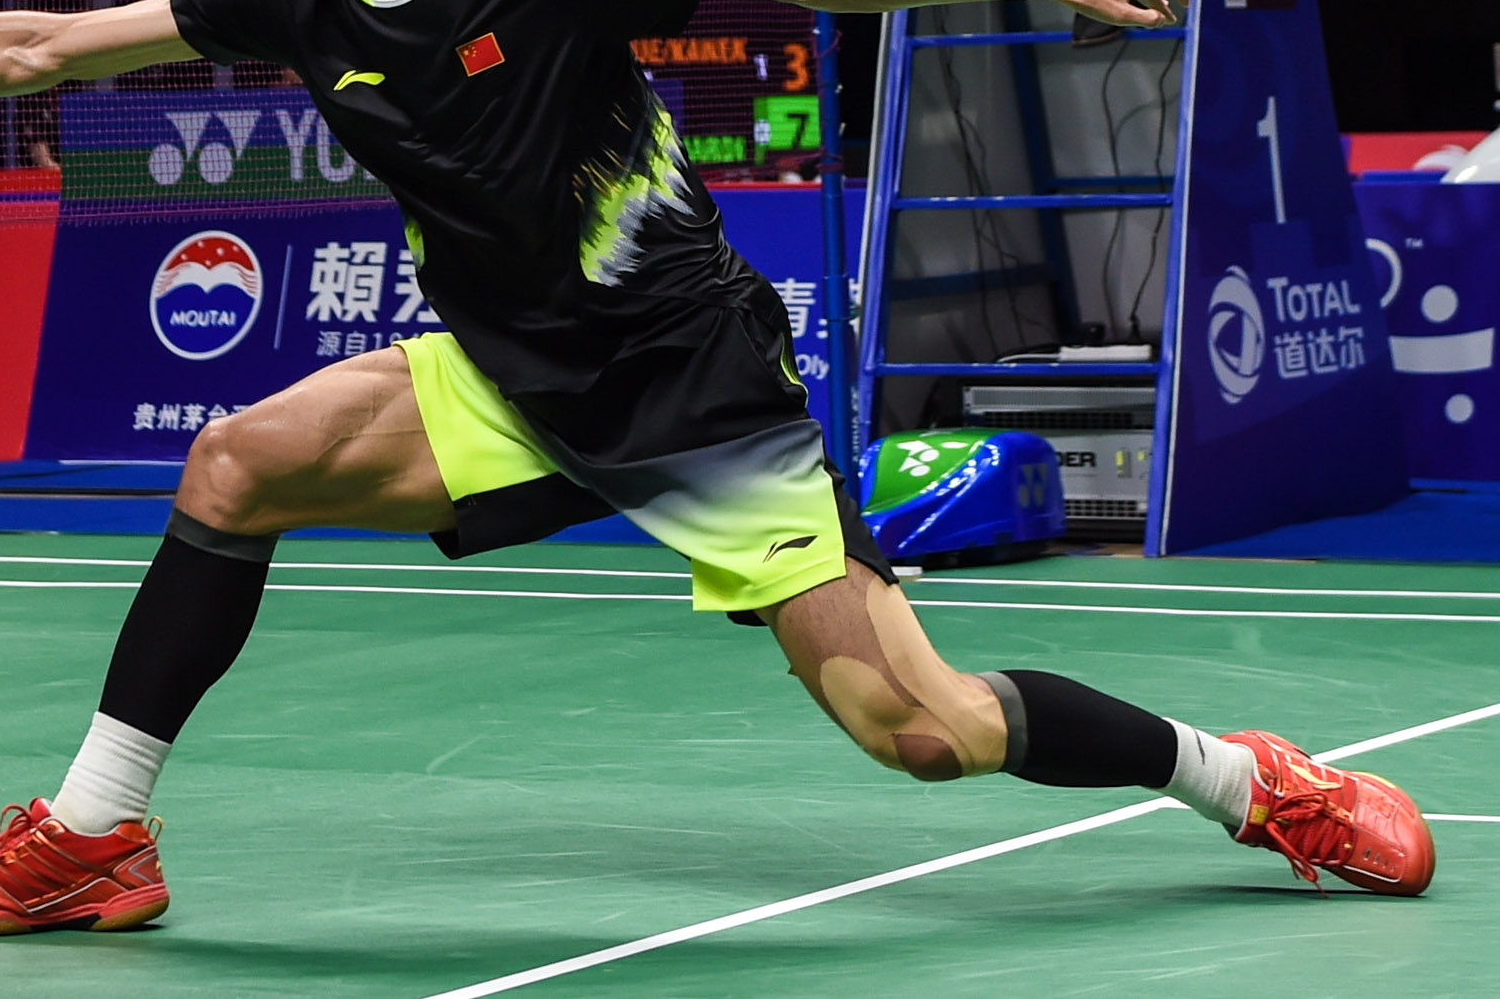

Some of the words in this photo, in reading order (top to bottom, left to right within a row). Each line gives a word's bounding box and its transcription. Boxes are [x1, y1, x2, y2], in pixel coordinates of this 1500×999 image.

[783, 43, 809, 92] 3
[275, 108, 362, 184] YO
[787, 113, 809, 149] 7
[1257, 96, 1286, 224] 1
[169, 309, 237, 328] MOUTAI
[1266, 276, 1361, 321] TOTAL
[797, 352, 831, 381] Oly
[1273, 325, 1366, 380] 道达尔
